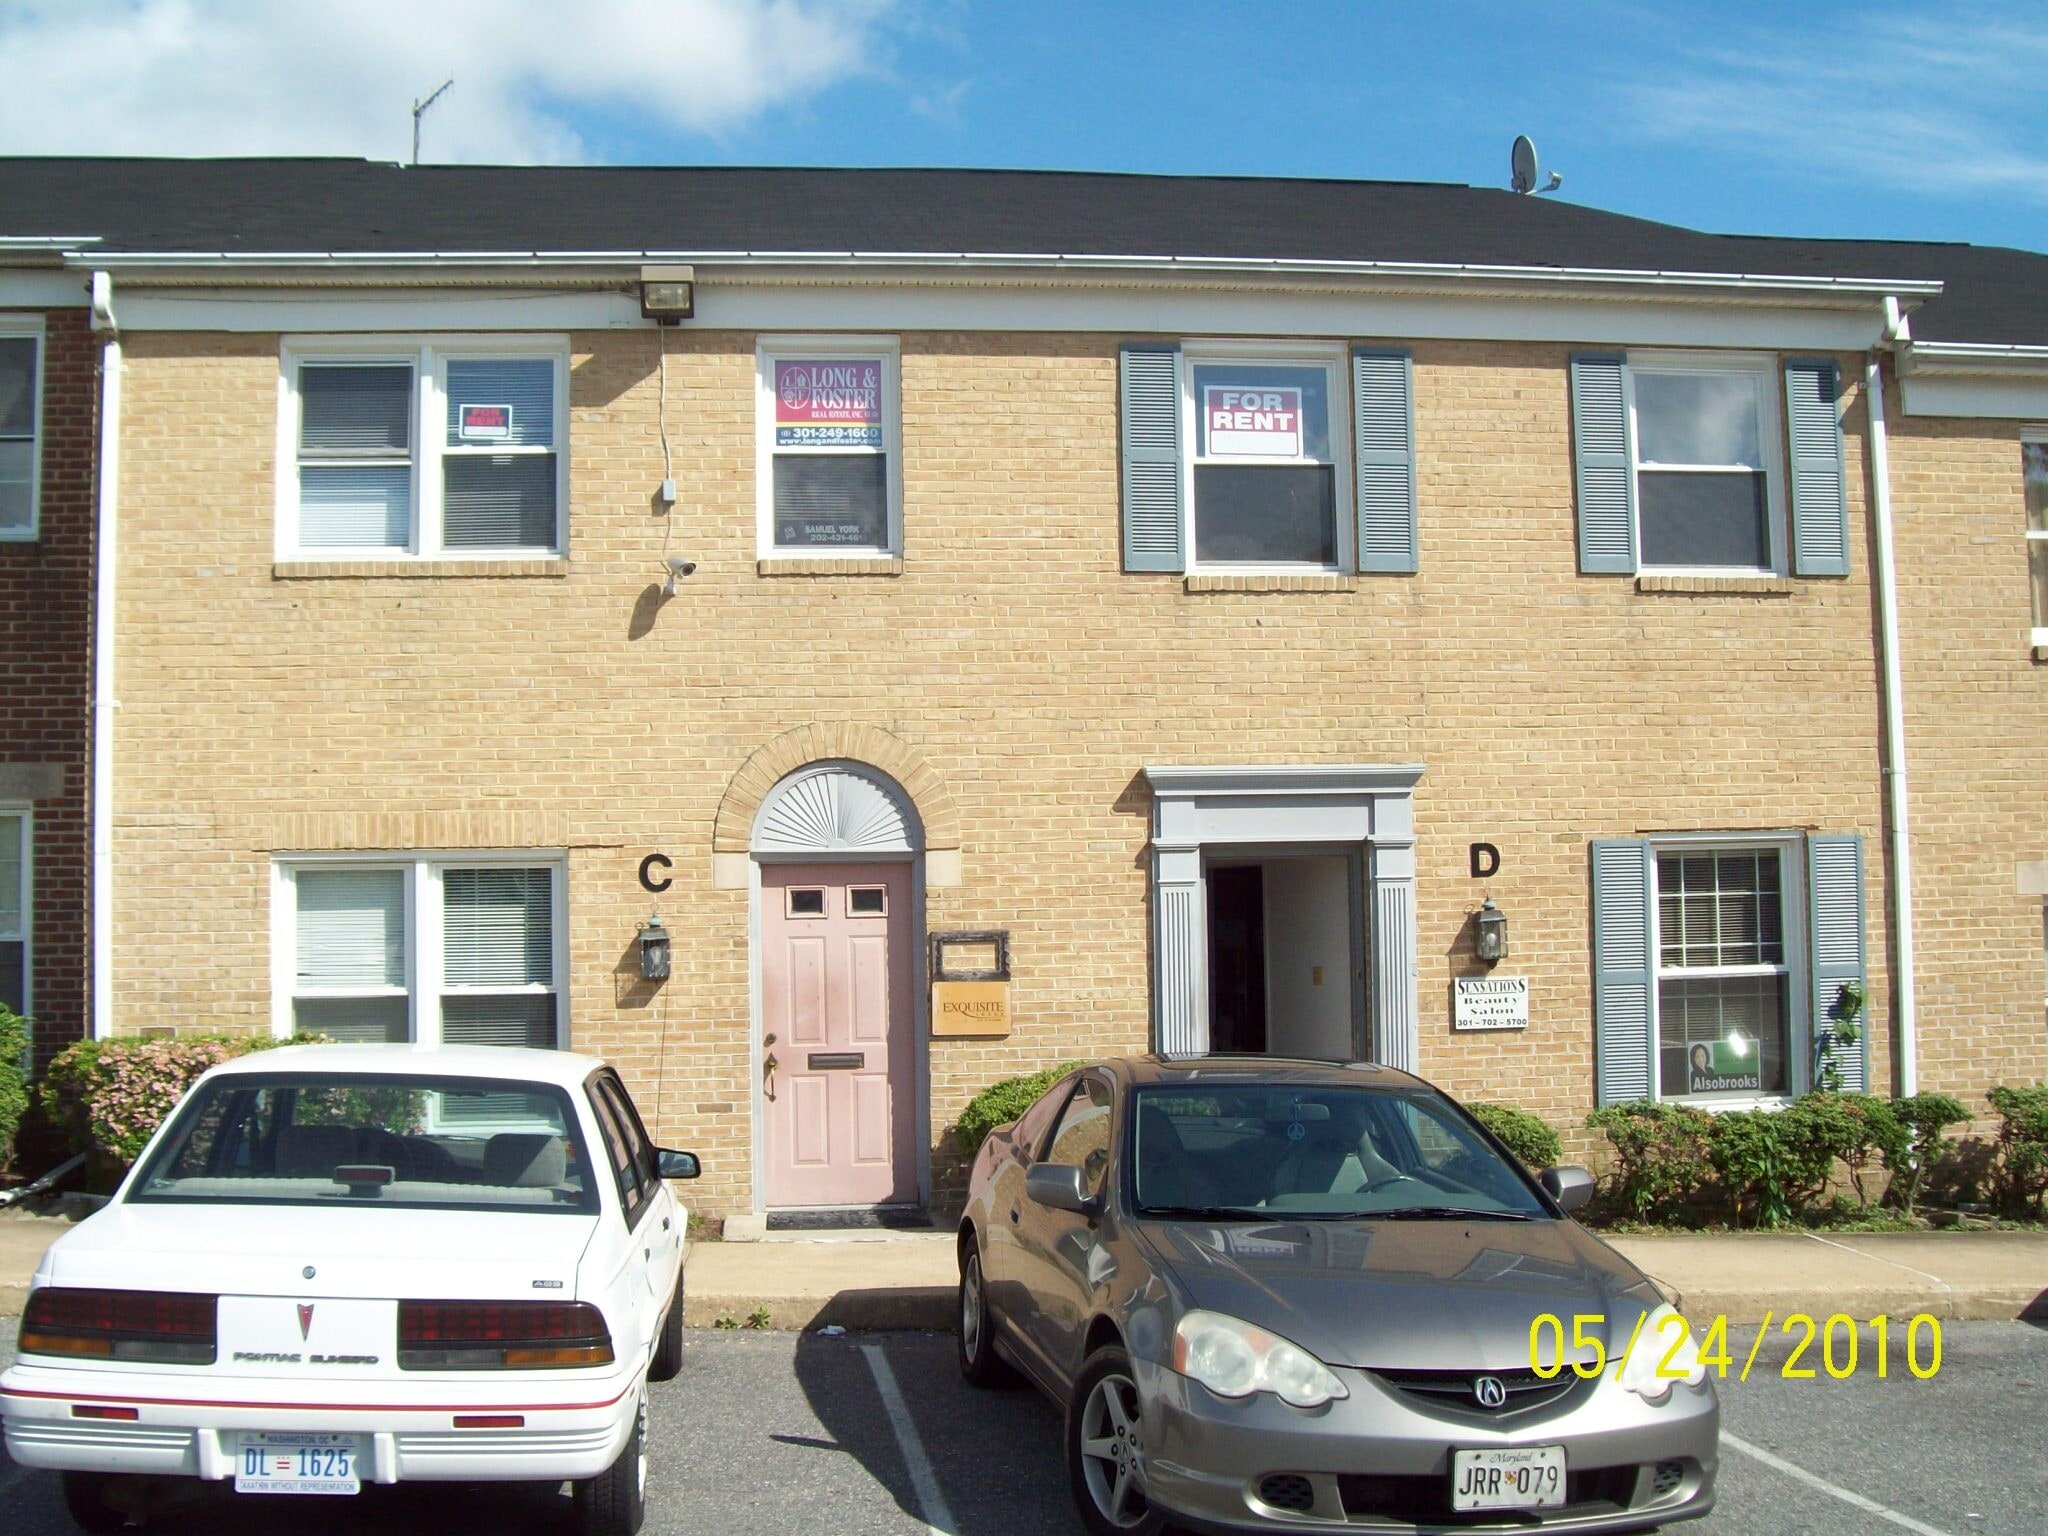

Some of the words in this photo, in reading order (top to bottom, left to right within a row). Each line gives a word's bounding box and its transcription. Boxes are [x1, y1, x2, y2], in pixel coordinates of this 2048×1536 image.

[811, 367, 857, 388] LONG
[863, 367, 878, 388] &
[811, 388, 878, 409] FOSTER
[1222, 393, 1283, 411] FOR
[471, 408, 501, 417] FOR
[466, 416, 505, 425] RENT
[1213, 411, 1294, 431] RENT
[793, 428, 879, 438] 301-249-1600
[1470, 842, 1501, 878] D
[638, 853, 673, 893] C
[943, 1001, 1004, 1014] EXQUISITE
[1464, 997, 1519, 1005] Beauty
[1470, 1007, 1514, 1015] Salon
[1693, 1075, 1758, 1091] Alsobrooks
[233, 1352, 302, 1362] PONTIAC
[245, 1448, 271, 1476] DL
[298, 1449, 349, 1477] 1625
[1489, 1452, 1533, 1465] Maryland
[271, 1482, 298, 1490] WITHOUT
[1459, 1467, 1502, 1495] JRR
[1517, 1466, 1558, 1494] 079
